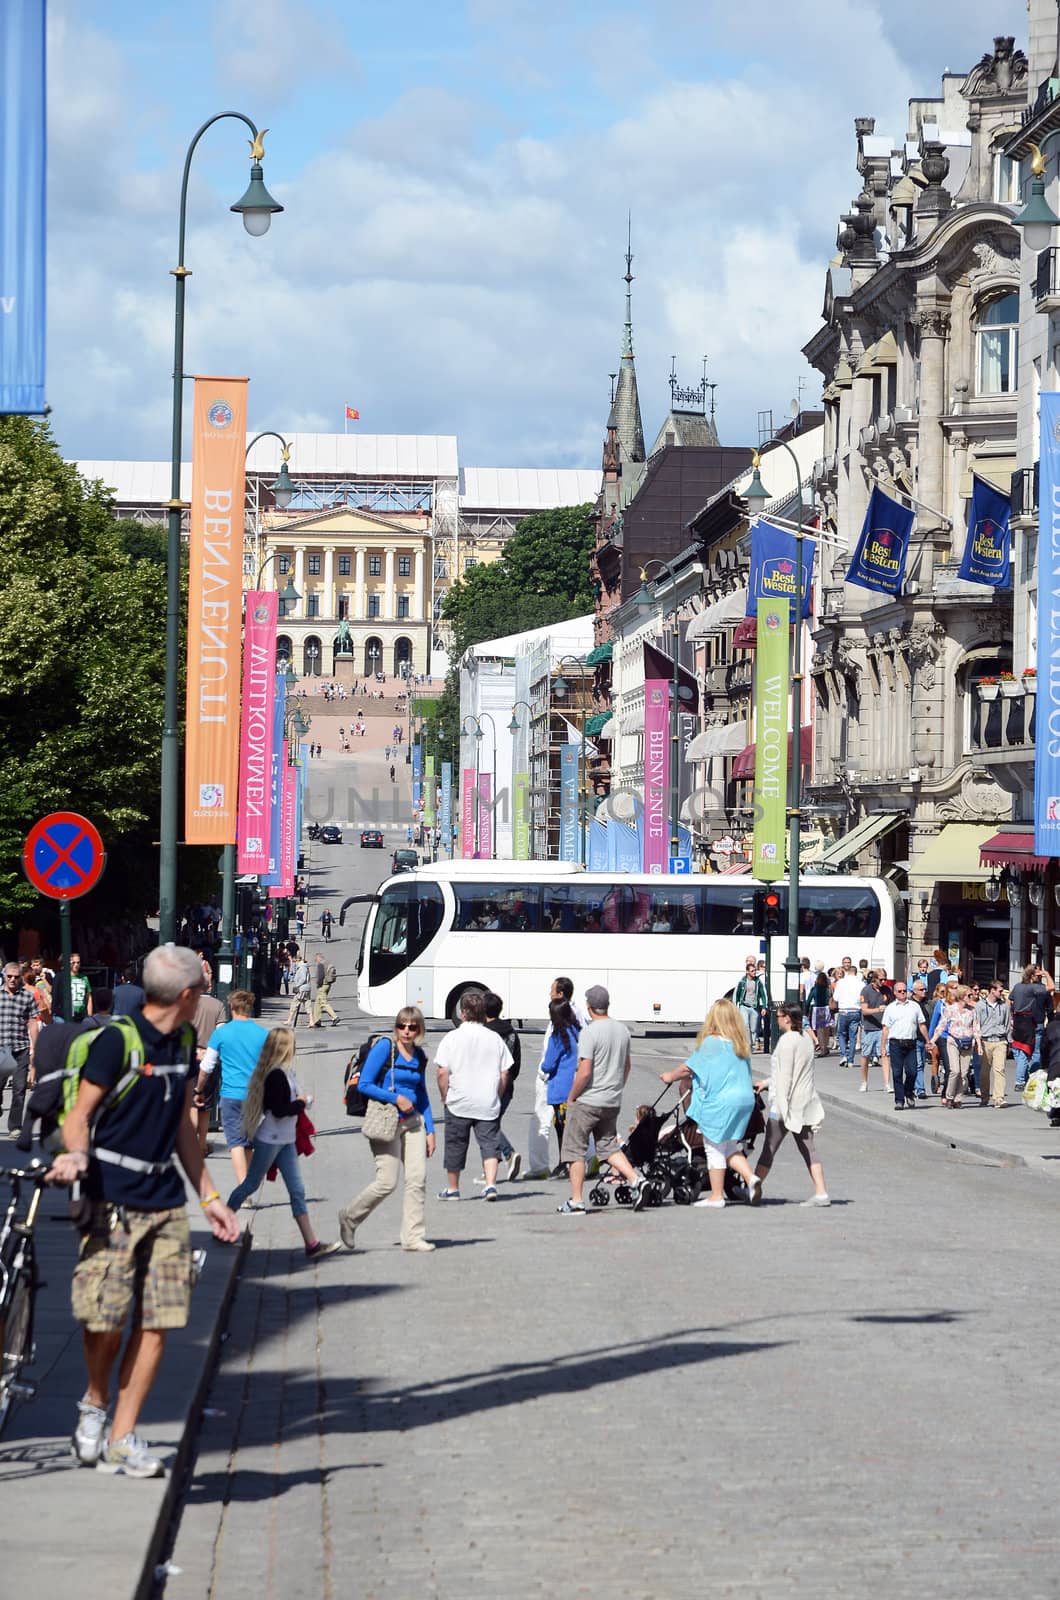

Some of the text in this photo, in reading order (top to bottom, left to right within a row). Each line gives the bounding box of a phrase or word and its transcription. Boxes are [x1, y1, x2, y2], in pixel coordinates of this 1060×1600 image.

[771, 569, 796, 585] Best
[762, 675, 782, 799] WELCOME
[649, 731, 665, 838] BIENVENUE
[674, 859, 685, 874] P
